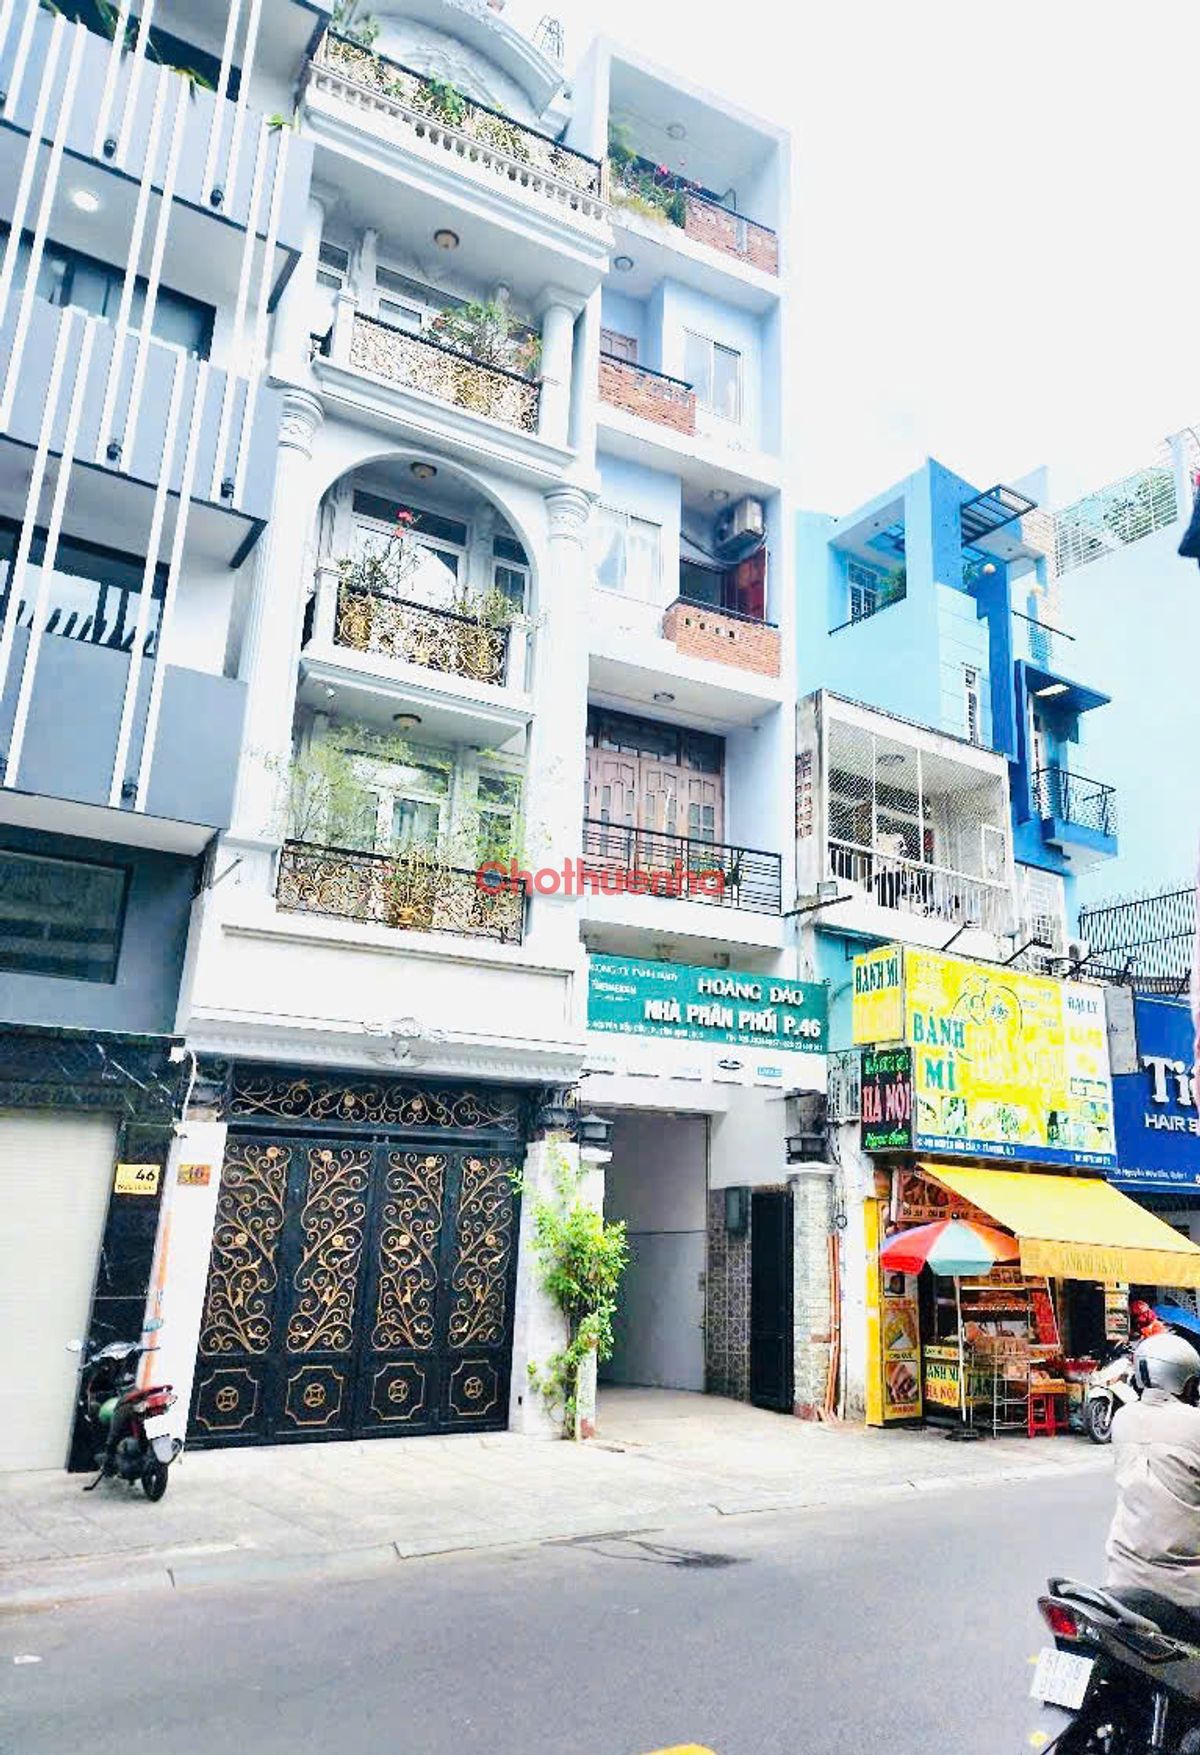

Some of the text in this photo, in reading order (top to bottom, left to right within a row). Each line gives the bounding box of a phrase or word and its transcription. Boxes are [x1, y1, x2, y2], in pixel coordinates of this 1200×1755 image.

[698, 977, 761, 1000] HOÀNG
[644, 997, 822, 1038] NHÀ PHÂN PHỐI P.46
[913, 1006, 965, 1049] BÁNH
[925, 1051, 955, 1091] MÌ
[863, 1072, 911, 1129] HÀ NỘI
[1144, 1113, 1186, 1132] HAIR
[136, 1169, 155, 1181] 46
